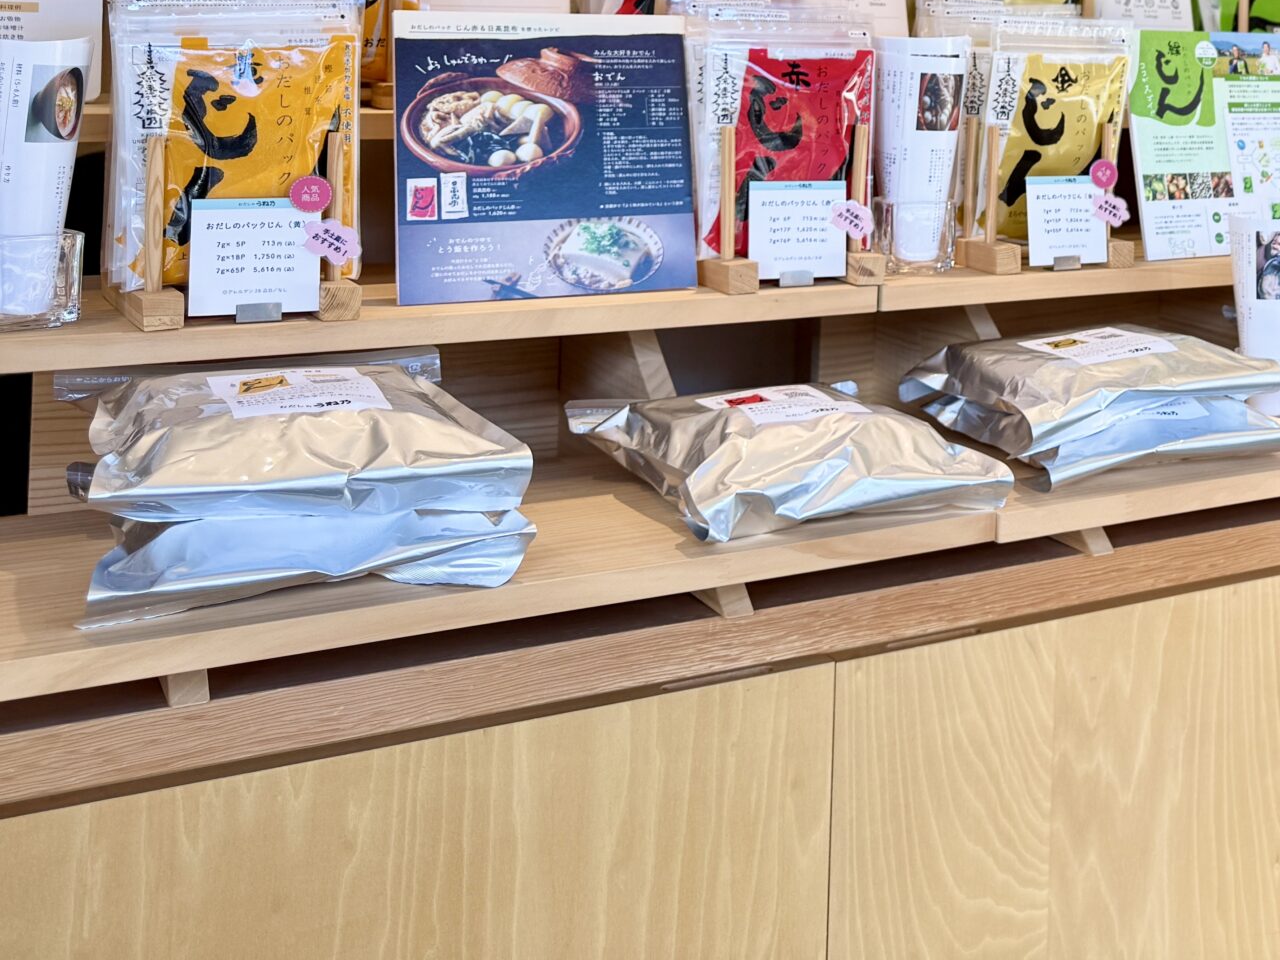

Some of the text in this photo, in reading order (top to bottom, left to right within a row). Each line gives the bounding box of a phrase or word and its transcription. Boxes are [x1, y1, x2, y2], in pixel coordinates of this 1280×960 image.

[592, 72, 626, 81] おでん
[781, 61, 811, 90] 赤
[1052, 67, 1078, 94] 金
[276, 56, 295, 186] おだしのパック
[815, 66, 830, 175] おだしのパック
[301, 185, 320, 193] 人気
[301, 194, 320, 202] 商品
[311, 233, 349, 257] おすすめ！
